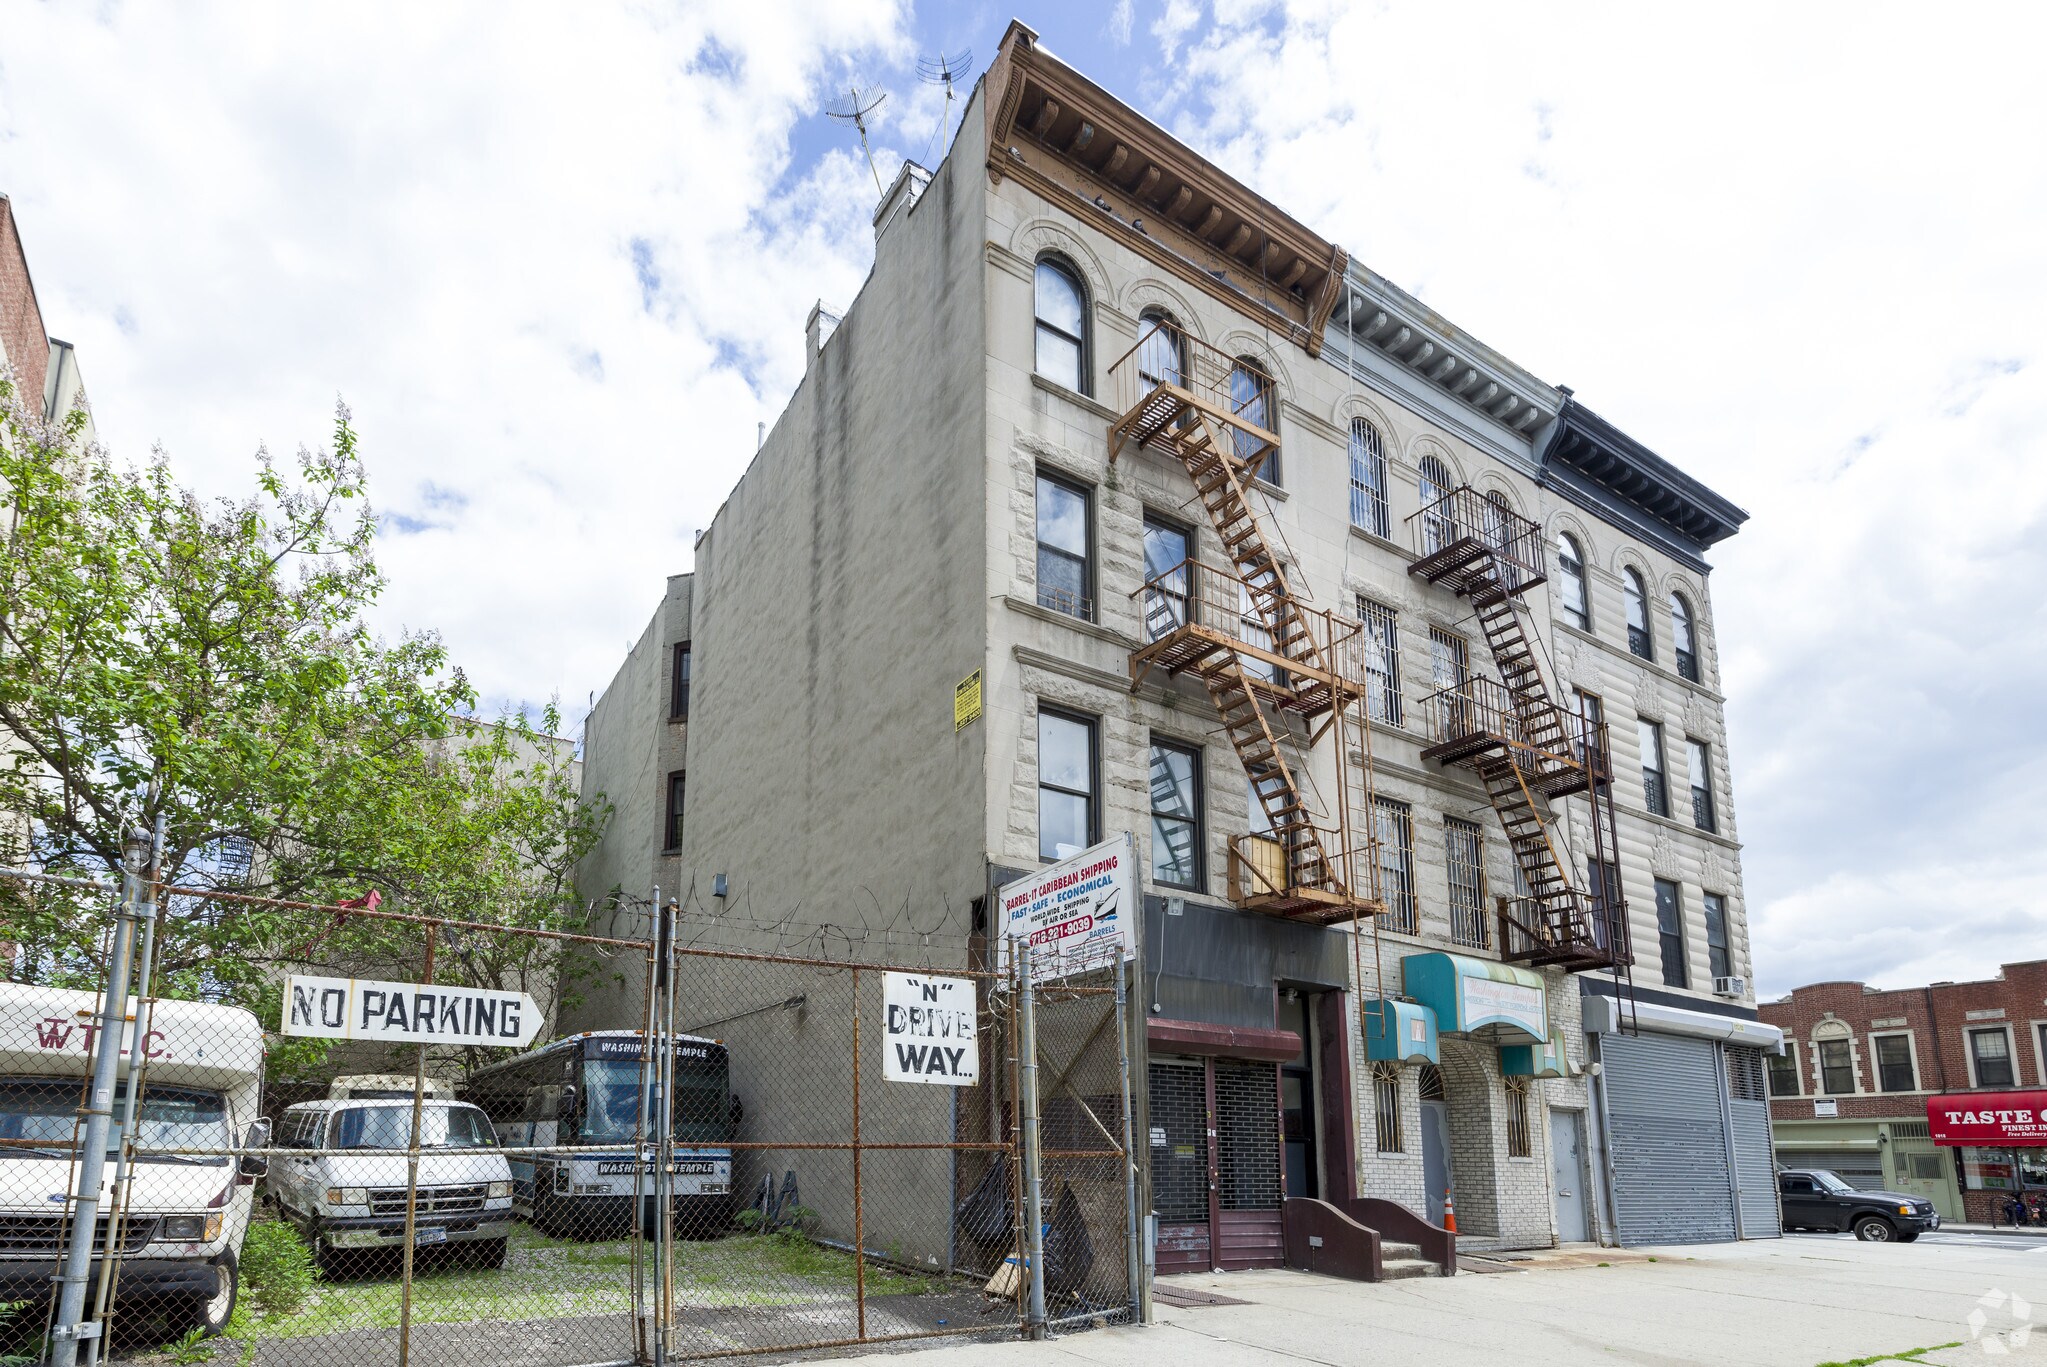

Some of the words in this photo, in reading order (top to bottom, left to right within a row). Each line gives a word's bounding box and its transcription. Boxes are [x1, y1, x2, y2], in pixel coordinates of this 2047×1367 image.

[1006, 888, 1037, 910] BARREL-IT
[1038, 871, 1079, 897] CARIBBEAN
[1080, 855, 1118, 881] SHIPPING
[1011, 906, 1028, 921] FAST
[1032, 897, 1049, 912] SAFE
[1057, 874, 1113, 903] ECONOMICAL
[1064, 896, 1090, 911] SHIPPING
[1049, 915, 1059, 925] AIR
[1060, 912, 1068, 921] OR
[1068, 909, 1079, 918] SEA
[1030, 917, 1090, 946] 718-221-9039
[1089, 924, 1116, 938] BARRELS
[1469, 979, 1509, 1001] Washington
[1512, 986, 1538, 1004] Temple
[290, 985, 346, 1028] NO
[360, 989, 521, 1038] PARKING
[888, 1004, 973, 1040] DRIVE
[1945, 1109, 2033, 1125] TASTE
[2001, 1124, 2037, 1132] FINEST
[674, 1163, 713, 1174] TEMPLE
